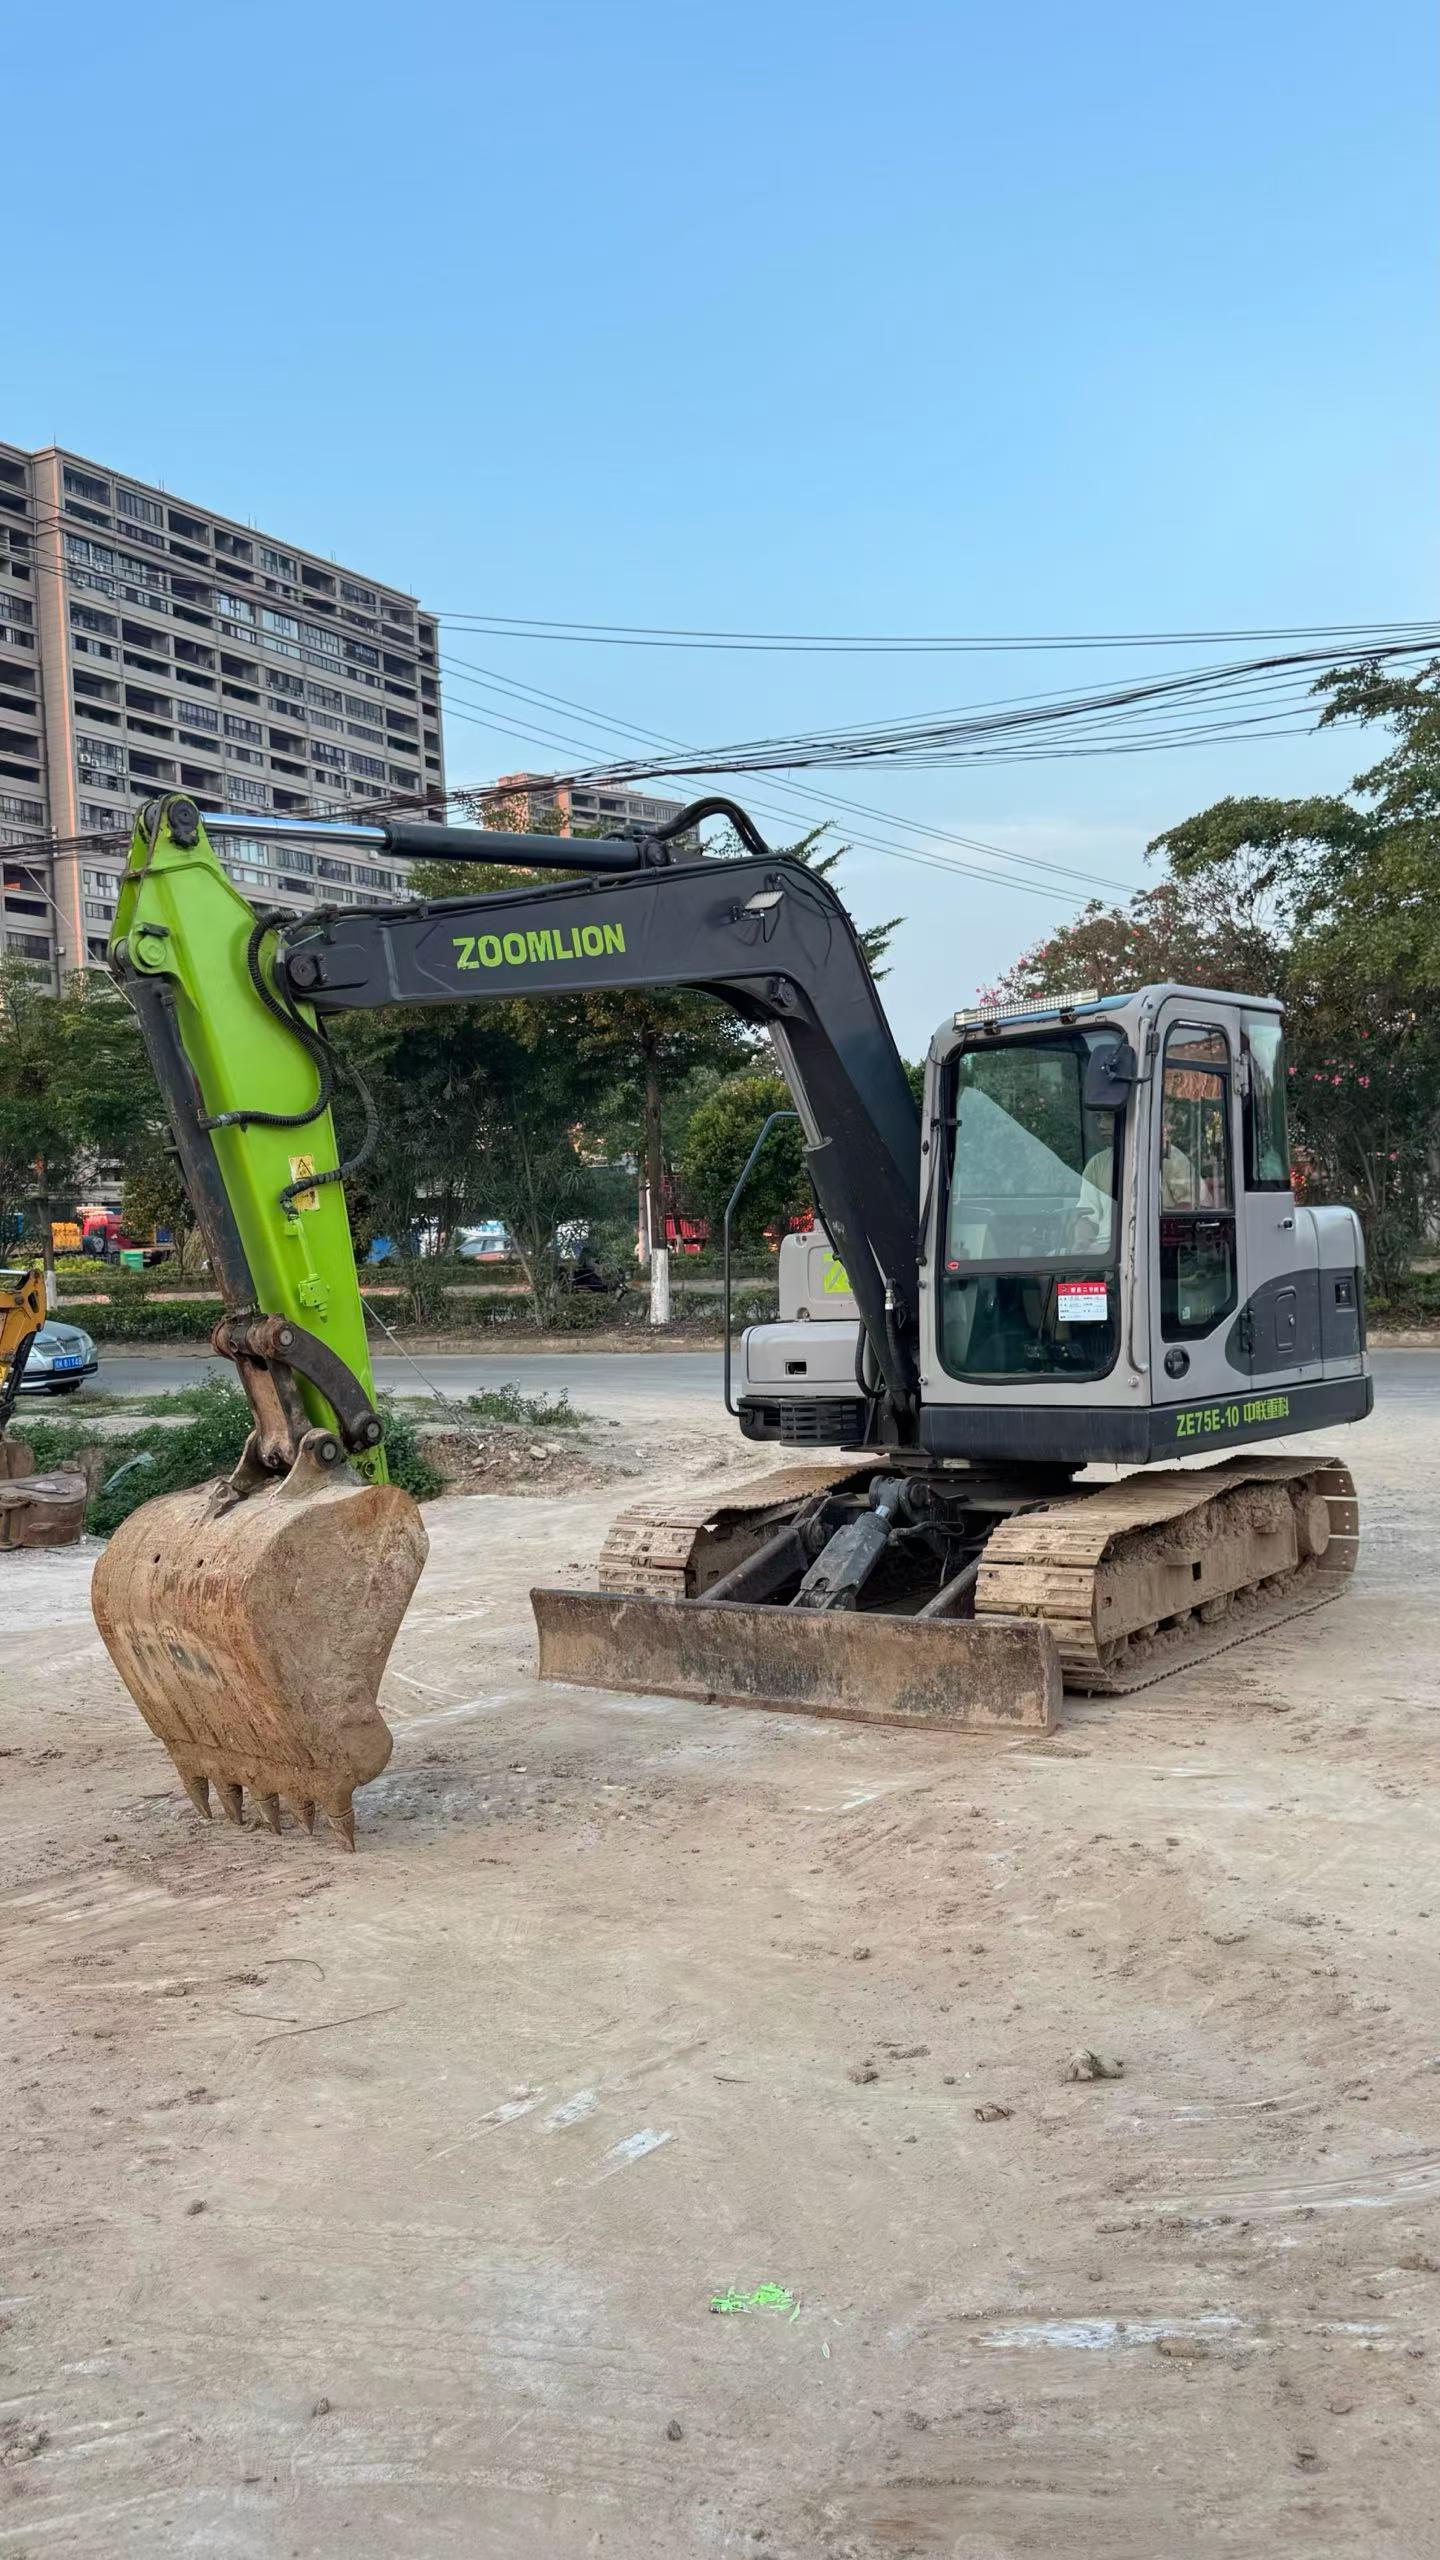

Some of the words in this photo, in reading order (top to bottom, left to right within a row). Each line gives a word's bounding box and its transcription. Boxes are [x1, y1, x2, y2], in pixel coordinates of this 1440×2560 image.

[452, 923, 626, 970] ZOOMLION
[1176, 1406, 1239, 1437] ZE75E-10
[1243, 1396, 1290, 1423] 中联重科
